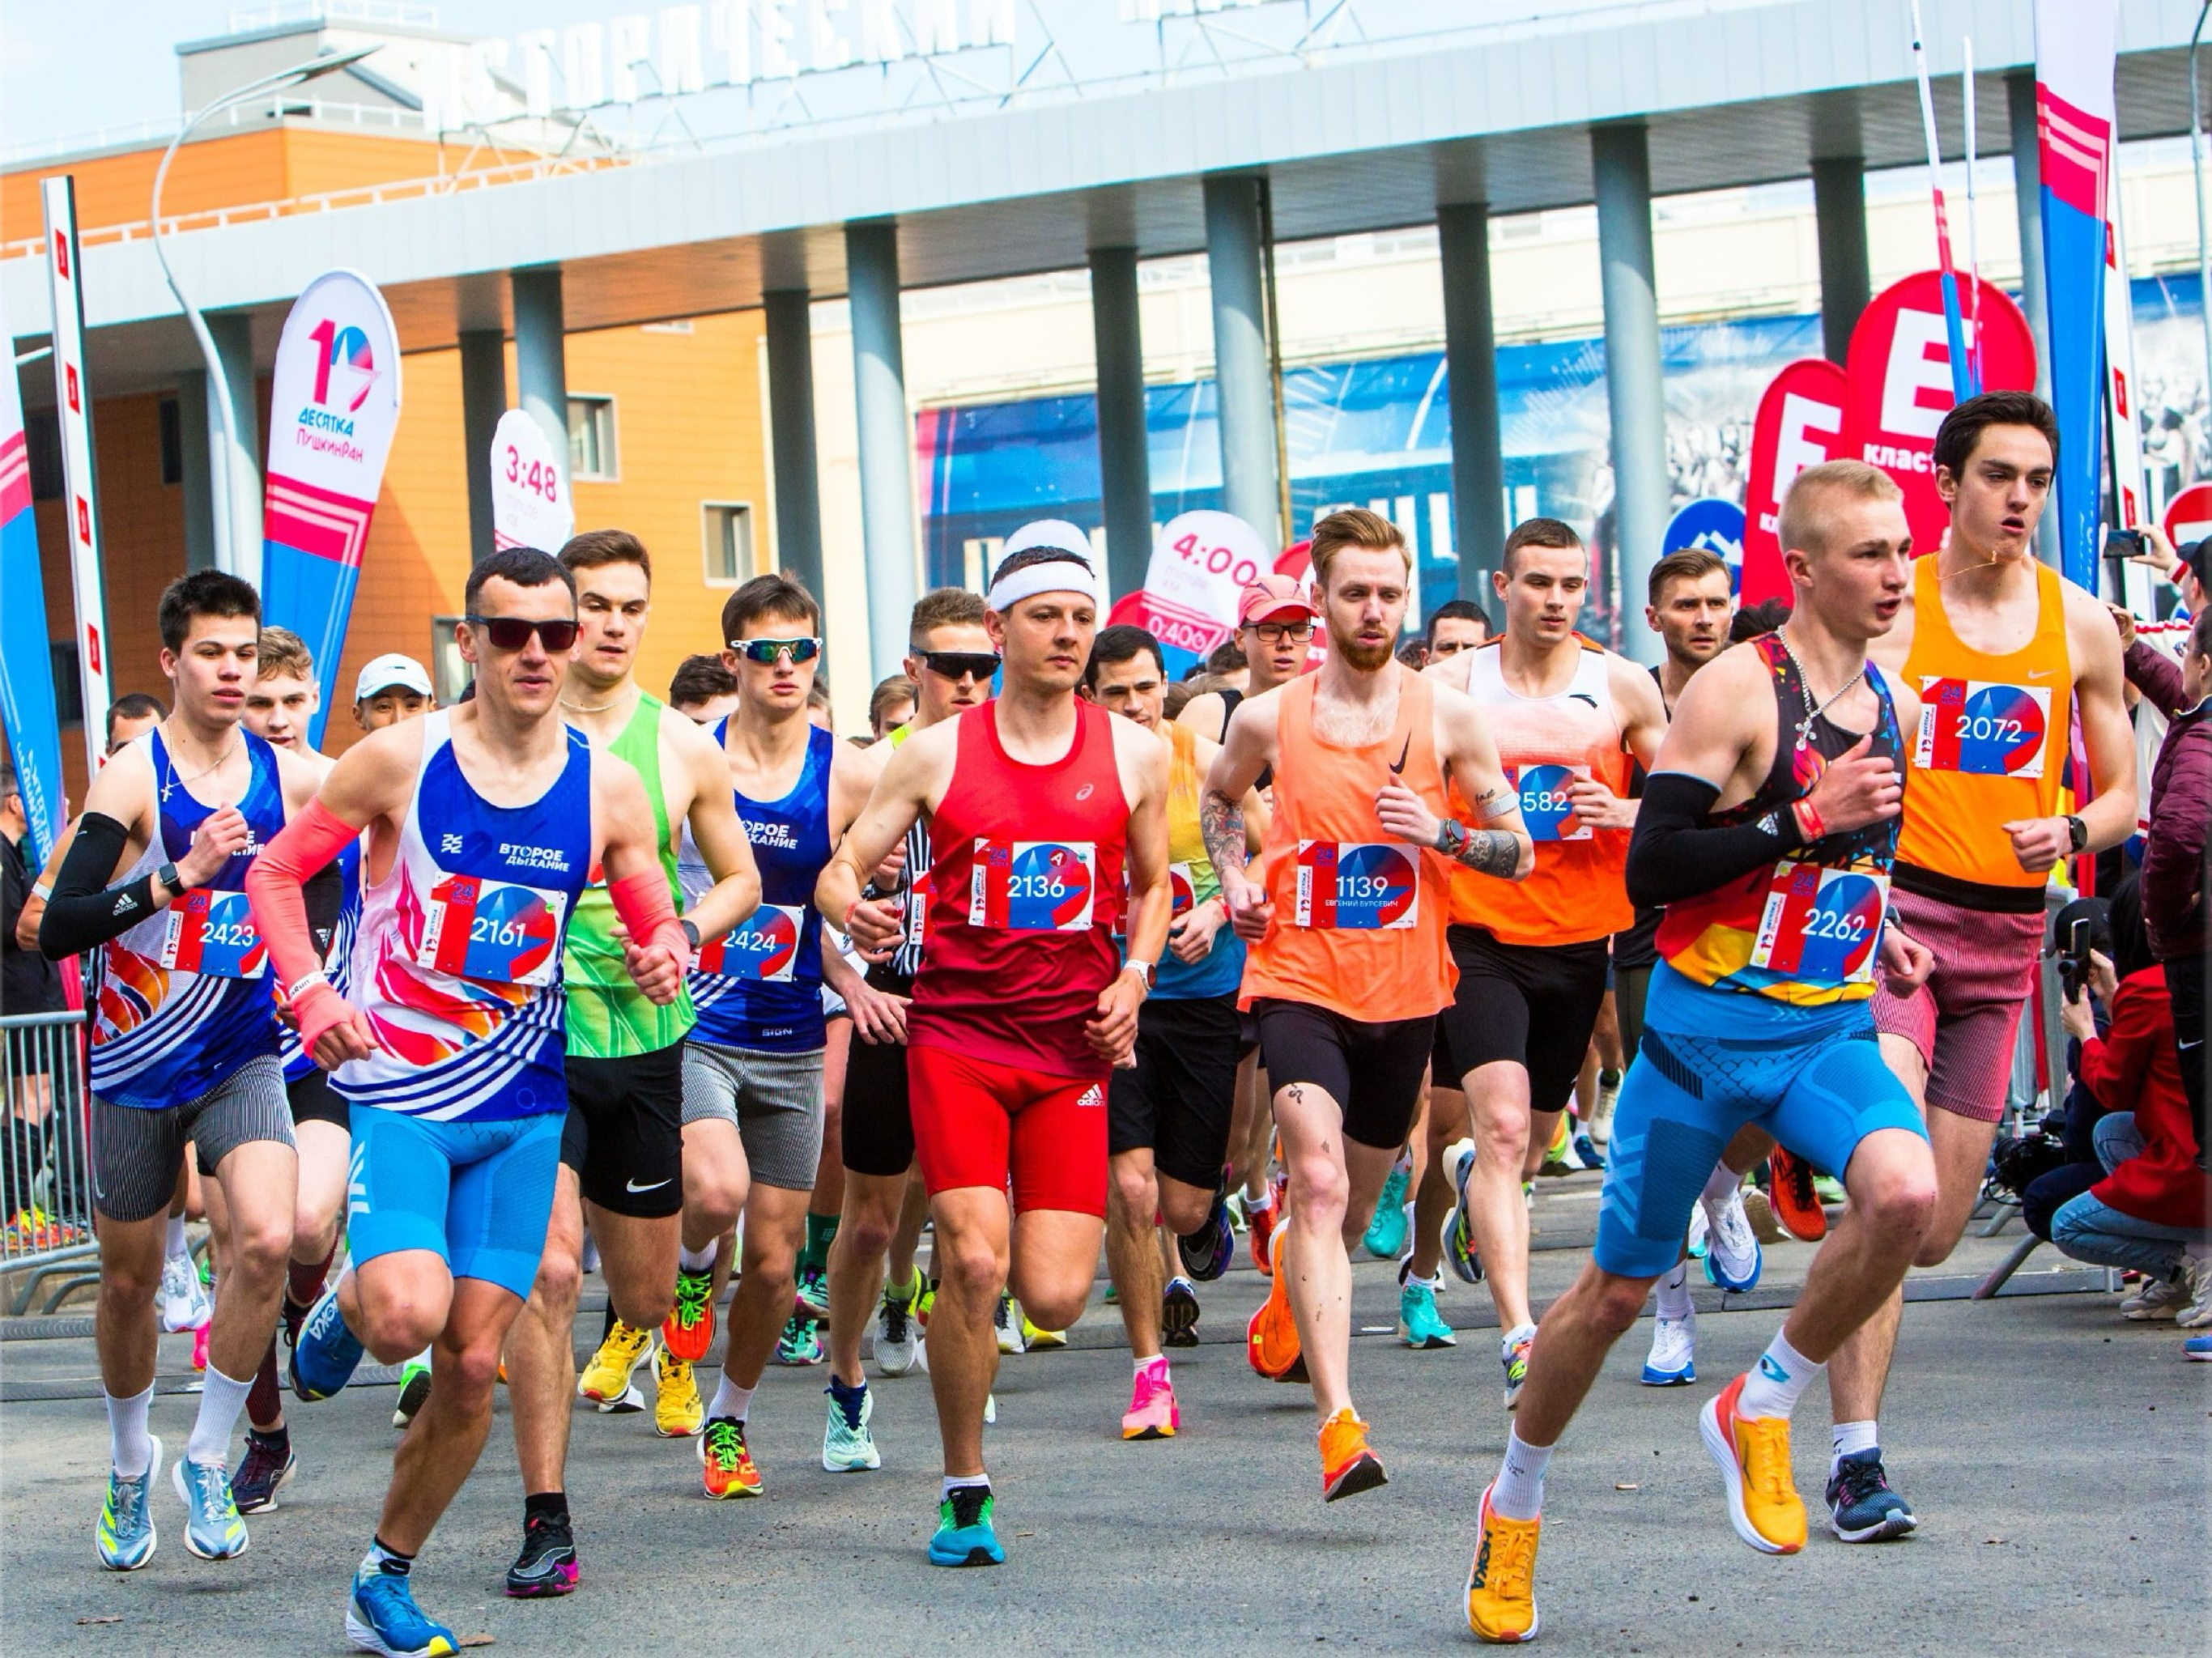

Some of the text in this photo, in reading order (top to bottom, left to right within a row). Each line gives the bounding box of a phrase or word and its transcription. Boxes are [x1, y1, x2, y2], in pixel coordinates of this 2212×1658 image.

[298, 407, 355, 438] ДЕСЯТКА
[506, 444, 556, 503] 3:48
[1172, 533, 1257, 586] 4:00
[1955, 715, 2023, 742] 2072
[1523, 792, 1568, 812] 582
[499, 843, 564, 862] ВТОРОЕ
[505, 856, 570, 873] ДЫХАНИЕ
[1006, 875, 1066, 898] 2136
[1336, 876, 1389, 898] 1139
[112, 901, 138, 916] adidas
[1325, 899, 1398, 908] ЕВГЕНИЙ БУРСЕВИЧ
[199, 922, 254, 946] 2423
[470, 916, 526, 947] 2161
[1801, 908, 1866, 942] 2262
[721, 929, 776, 952] 2424
[1470, 1530, 1493, 1589] HOKA
